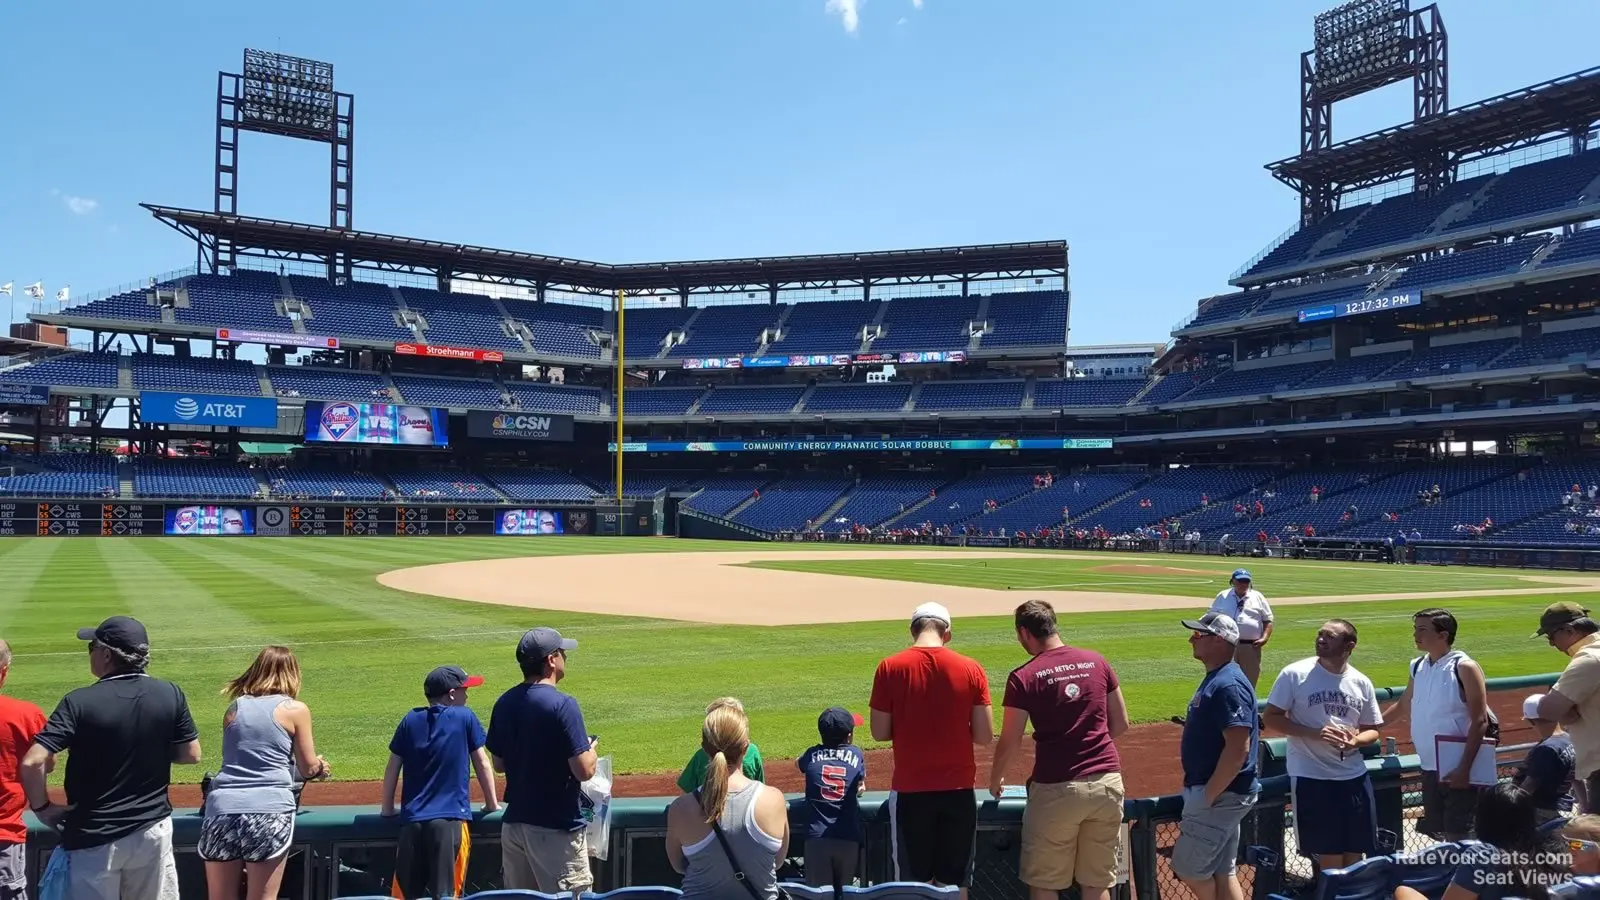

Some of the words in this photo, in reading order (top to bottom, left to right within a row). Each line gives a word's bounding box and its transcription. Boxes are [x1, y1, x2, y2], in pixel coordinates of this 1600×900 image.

[1346, 298, 1388, 313] 12:17:32
[1393, 295, 1409, 306] PM
[426, 346, 474, 358] Stroehmann
[203, 404, 246, 418] AT&T
[515, 416, 551, 430] CSN
[493, 429, 549, 437] CSNPHILLY.COM
[798, 442, 832, 450] ENERGY
[883, 441, 911, 449] SOLAR
[1036, 669, 1053, 678] 1980s
[1055, 664, 1075, 673] RETRO
[812, 749, 859, 768] FREEMAN
[821, 765, 846, 801] 5
